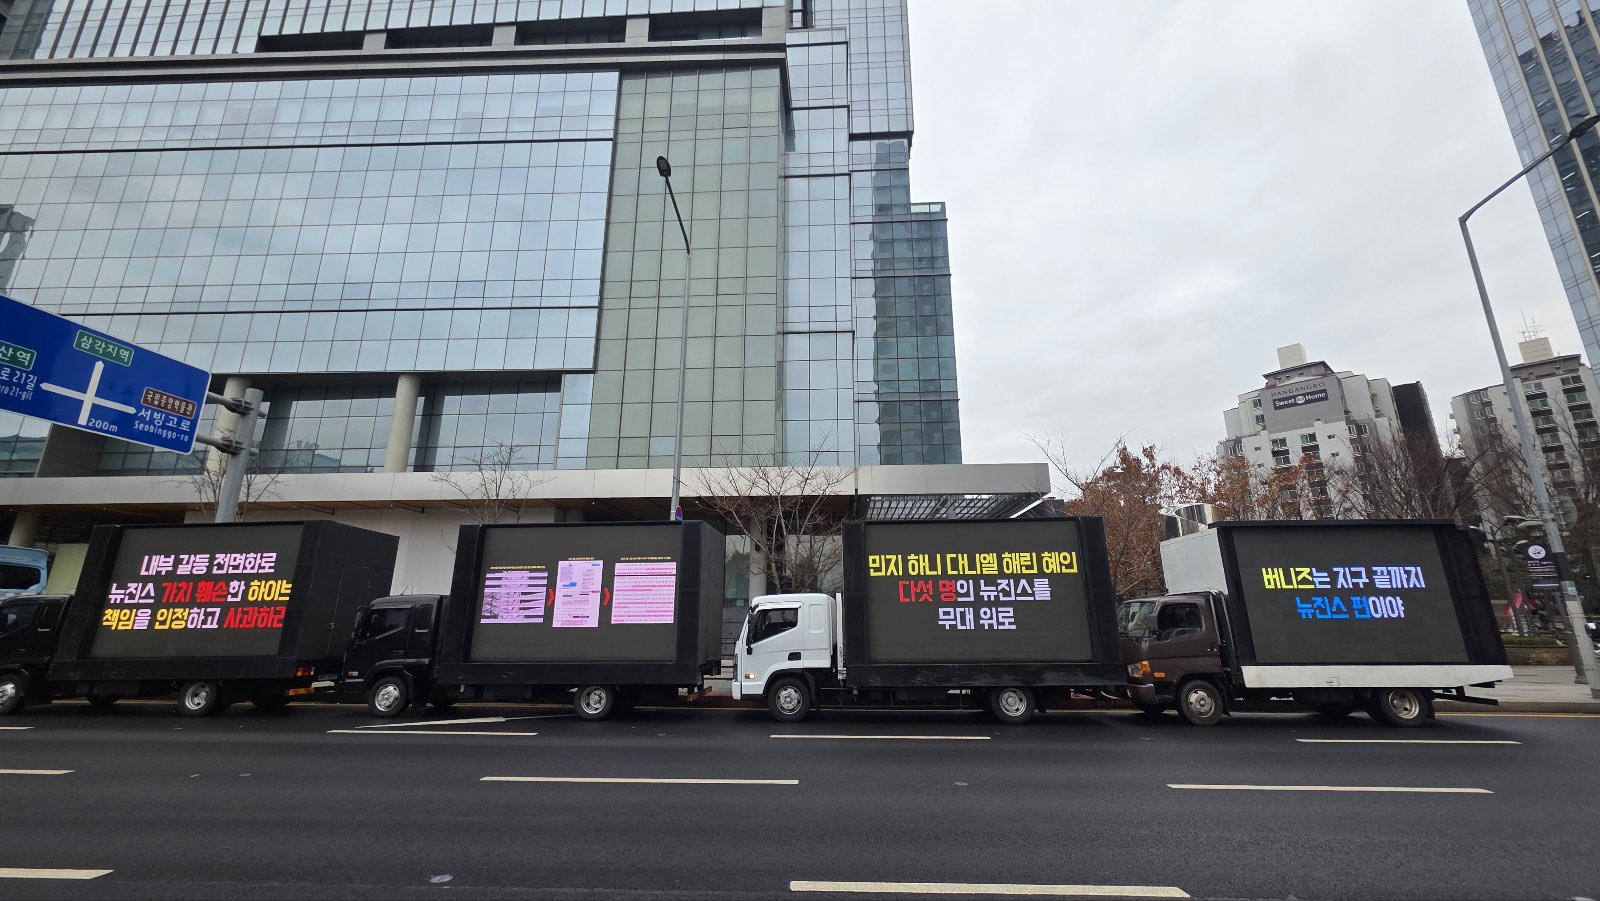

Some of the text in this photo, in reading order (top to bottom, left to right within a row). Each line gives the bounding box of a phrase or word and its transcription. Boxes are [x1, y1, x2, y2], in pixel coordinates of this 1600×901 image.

[0, 346, 31, 366] 산역
[81, 335, 130, 362] 삼각지역
[12, 371, 38, 391] 21길
[1271, 381, 1325, 397] HANGANGRO
[10, 386, 33, 401] 21-gil
[146, 391, 193, 415] 국립중앙박물관
[1274, 398, 1295, 407] Sweet
[1305, 392, 1326, 401] Home
[88, 418, 118, 433] 200m
[134, 420, 189, 442] Seobinggo-ro
[138, 408, 191, 432] 서빙고로
[140, 552, 277, 576] 내부 갈등 전면화로
[868, 551, 1079, 577] 민지 하니 다니엘 해린 혜인
[1261, 566, 1426, 589] 버니즈는 지구 끝까지
[108, 582, 155, 604] 뉴진스
[162, 581, 194, 604] 가치
[195, 580, 246, 604] 훼손한
[898, 578, 1051, 603] 다섯 명의 뉴진스를
[102, 608, 152, 630] 책임을
[154, 607, 222, 630] 인정하고
[938, 607, 1017, 630] 무대 위로
[1295, 596, 1405, 619] 뉴진스 편이야
